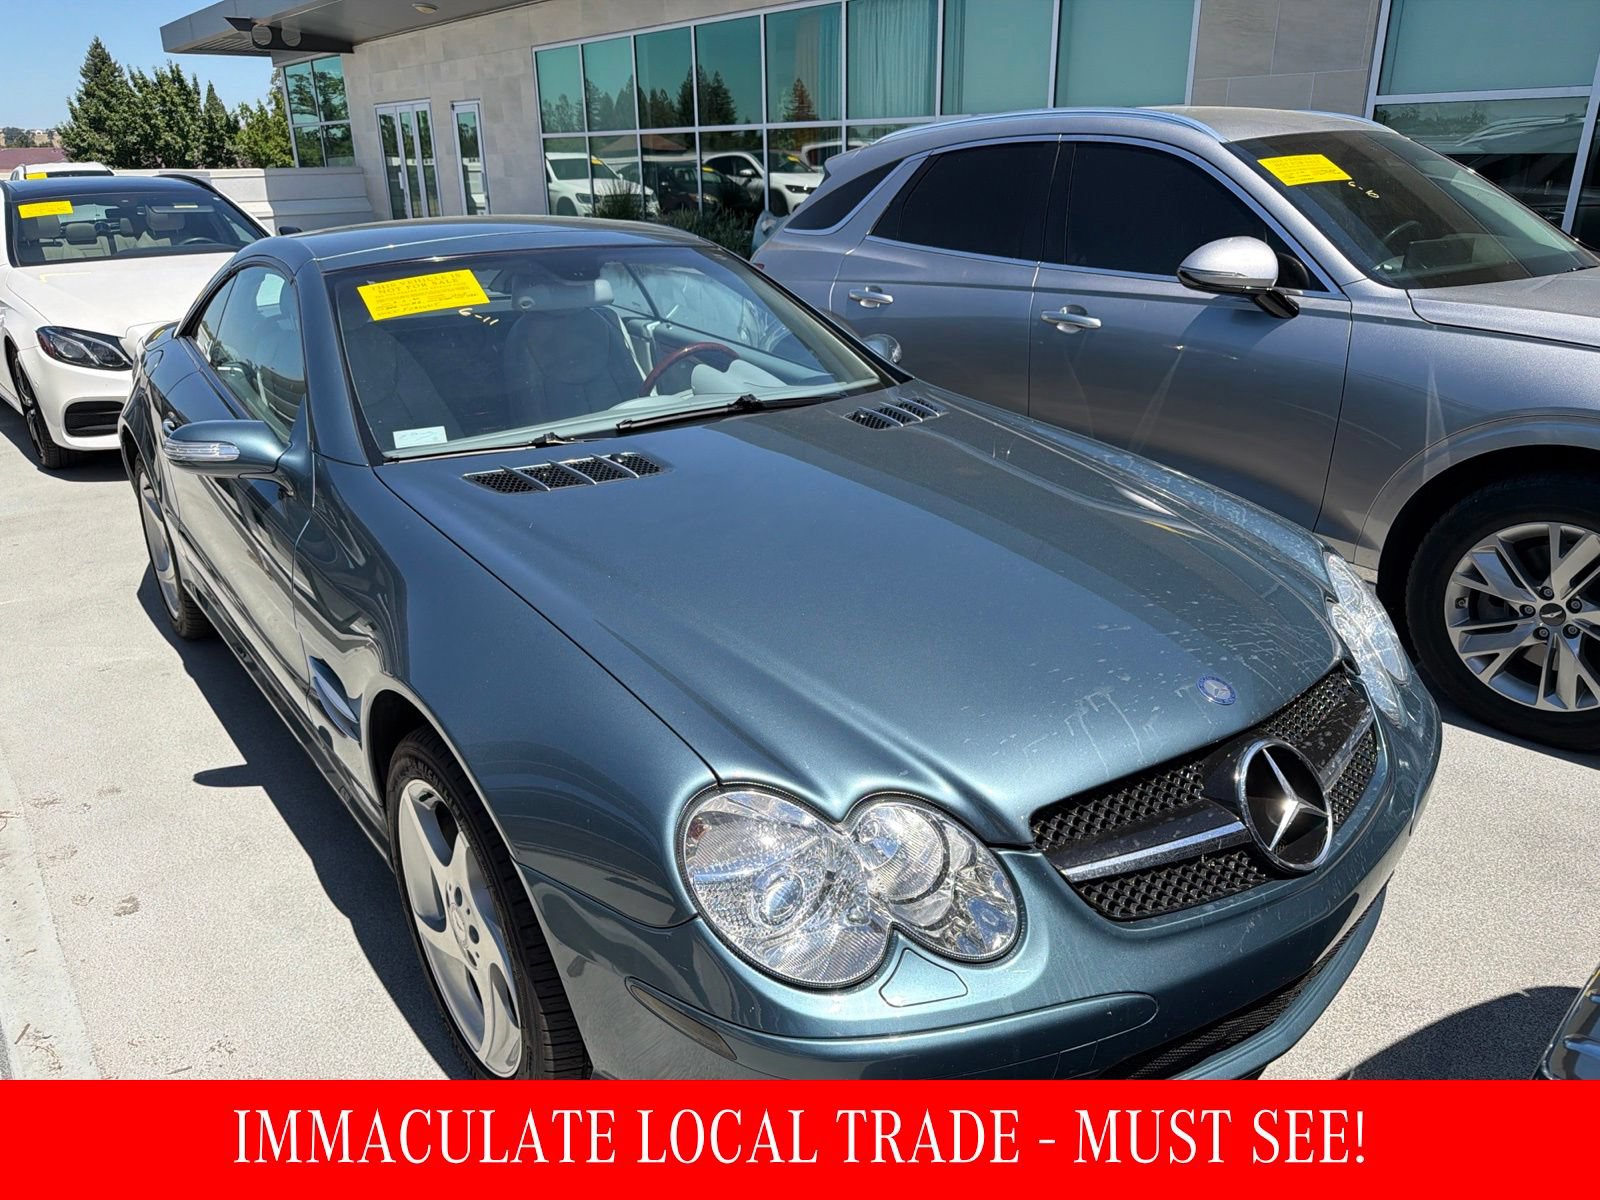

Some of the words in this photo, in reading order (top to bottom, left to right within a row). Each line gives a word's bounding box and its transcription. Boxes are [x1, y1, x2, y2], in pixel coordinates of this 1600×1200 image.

[378, 286, 401, 294] NOT
[406, 282, 428, 290] FOR
[432, 278, 460, 286] SALE
[401, 273, 447, 287] VEHICLE
